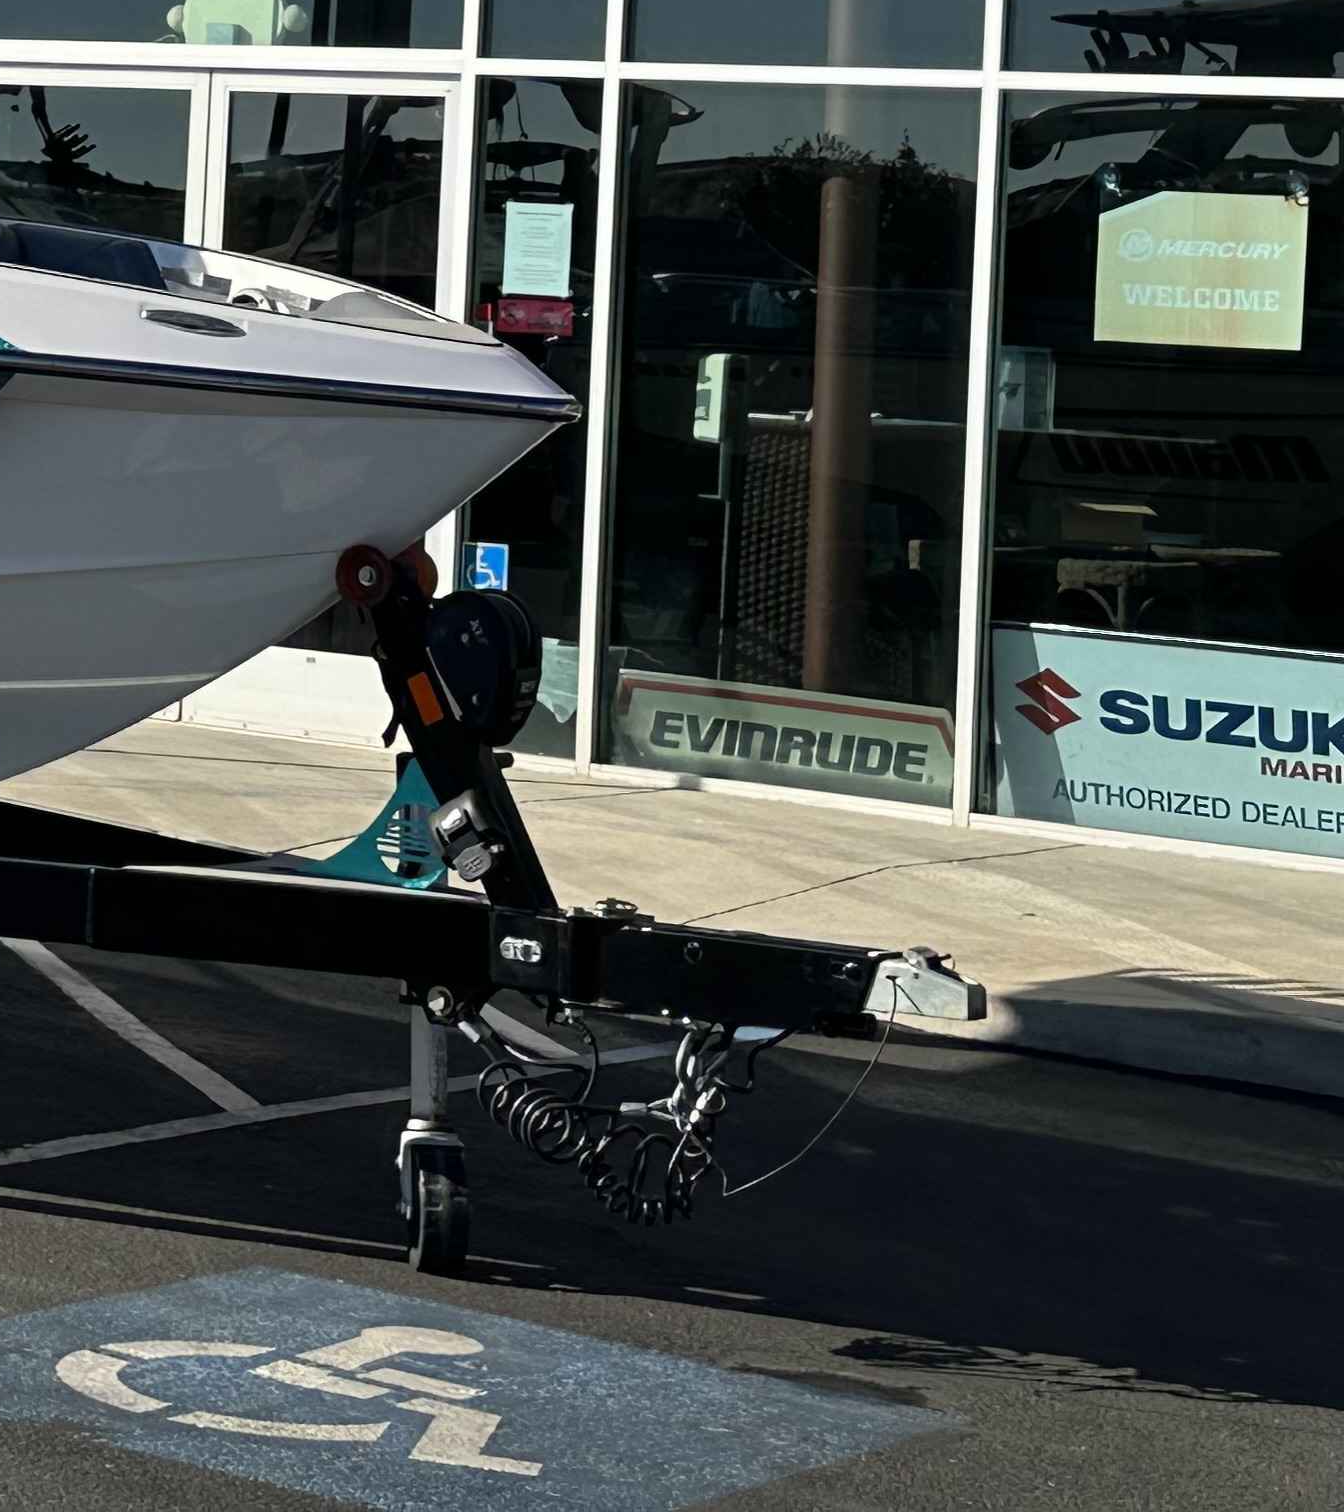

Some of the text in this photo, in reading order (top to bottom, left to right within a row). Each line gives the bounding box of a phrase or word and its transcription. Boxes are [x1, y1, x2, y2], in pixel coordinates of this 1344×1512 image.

[1157, 238, 1292, 261] MERCURY
[1121, 282, 1282, 313] WELCOME
[649, 709, 930, 784] EVINRUDE
[1052, 777, 1232, 820] AUTHORIZED
